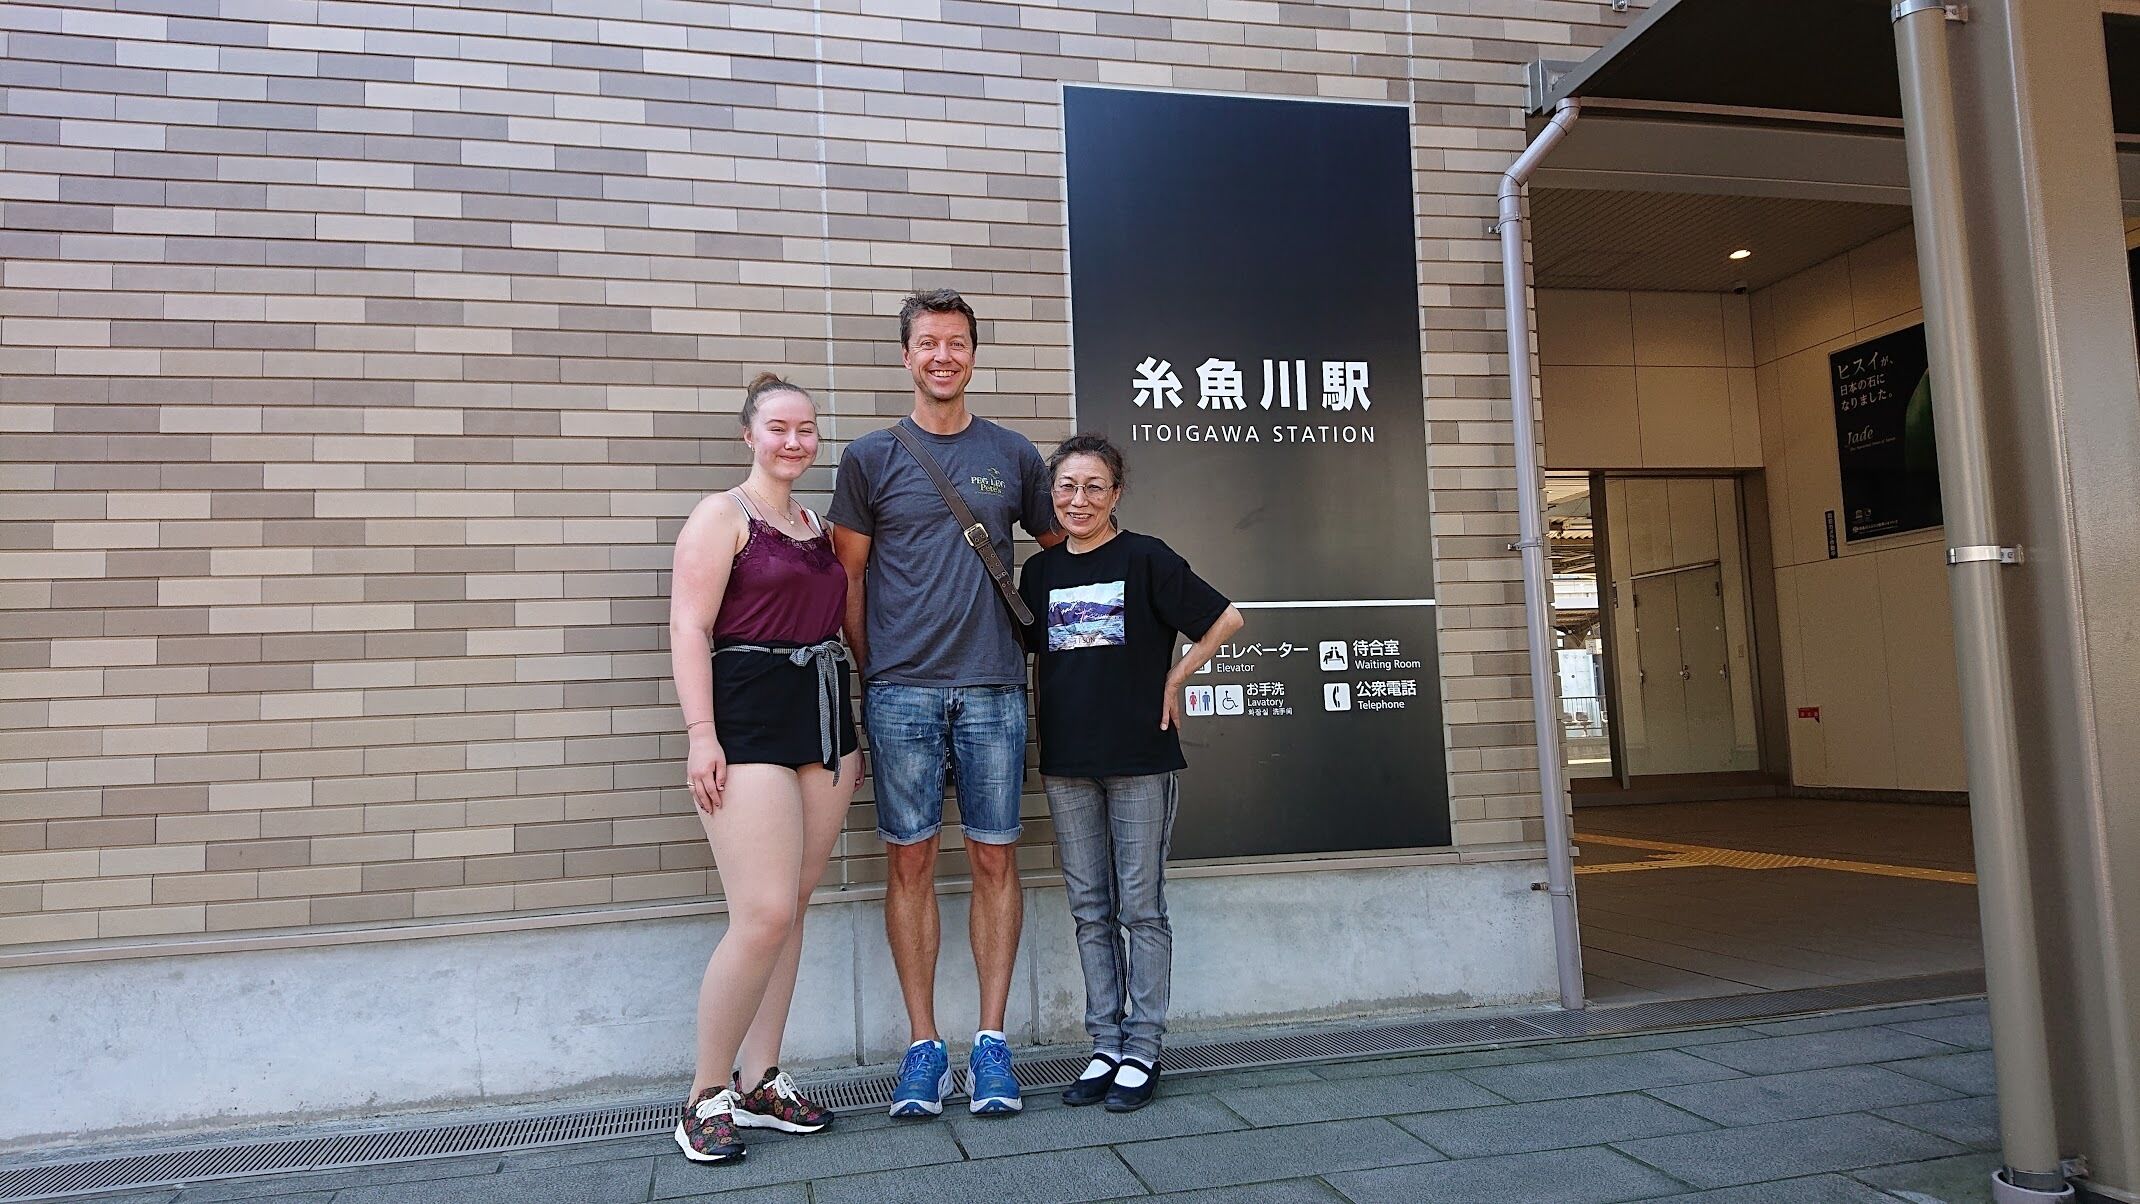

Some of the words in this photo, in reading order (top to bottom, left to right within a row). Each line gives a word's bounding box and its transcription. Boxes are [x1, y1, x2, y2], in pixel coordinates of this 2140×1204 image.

[1838, 351, 1893, 380] ヒスイが、
[1132, 356, 1371, 411] 糸魚川駅
[1840, 373, 1885, 396] 日本の石に
[1841, 388, 1893, 412] なりました。
[1132, 425, 1259, 442] ITOIGAWA
[1273, 426, 1374, 443] STATION
[1216, 642, 1308, 658] エレベーター
[1353, 640, 1400, 656] 待合室
[1217, 663, 1254, 672] Elevator
[1355, 659, 1391, 670] Waiting
[1394, 660, 1421, 668] Room
[1246, 682, 1284, 696] お手洗
[1356, 680, 1416, 696] 公衆電話
[1247, 698, 1284, 707] Lavatory
[1358, 700, 1405, 711] Telephone
